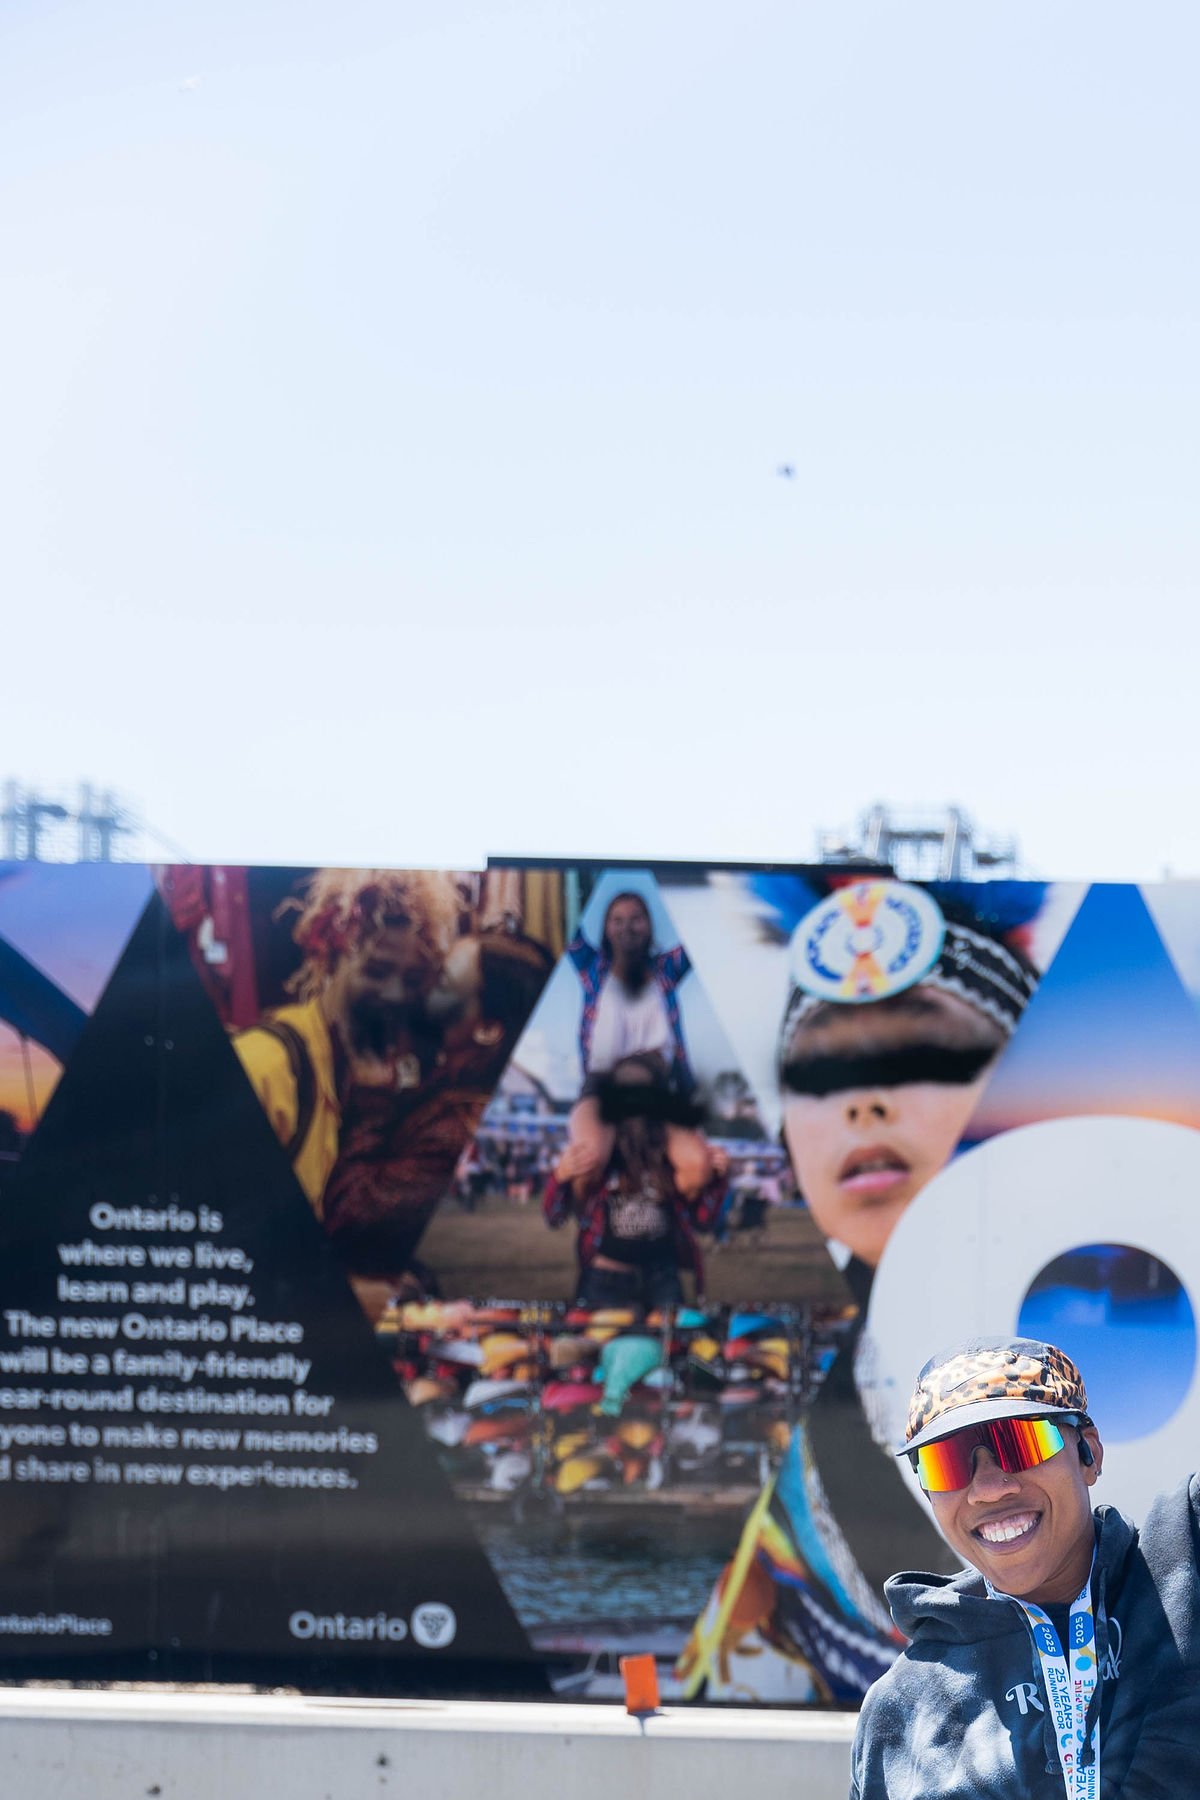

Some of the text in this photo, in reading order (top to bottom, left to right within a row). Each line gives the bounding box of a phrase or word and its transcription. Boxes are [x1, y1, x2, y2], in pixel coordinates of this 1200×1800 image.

[89, 1201, 224, 1233] Ontario is
[57, 1239, 254, 1273] where we live,
[57, 1274, 256, 1311] learn and play.
[3, 1309, 304, 1343] The new Ontario Place
[0, 1345, 312, 1385] will be a family-friendly
[0, 1384, 335, 1417] ear-round destination for
[0, 1421, 379, 1454] yone to make new memories
[14, 1454, 91, 1483] share
[93, 1455, 121, 1484] in
[123, 1462, 184, 1485] new
[186, 1460, 359, 1491] experiences.
[0, 1611, 113, 1636] ntarioPlace
[289, 1611, 408, 1642] Ontario
[1041, 1626, 1056, 1653] 2025
[1075, 1616, 1084, 1644] 2025
[1055, 1668, 1066, 1683] 25
[1047, 1667, 1065, 1730] RUNNING FOR
